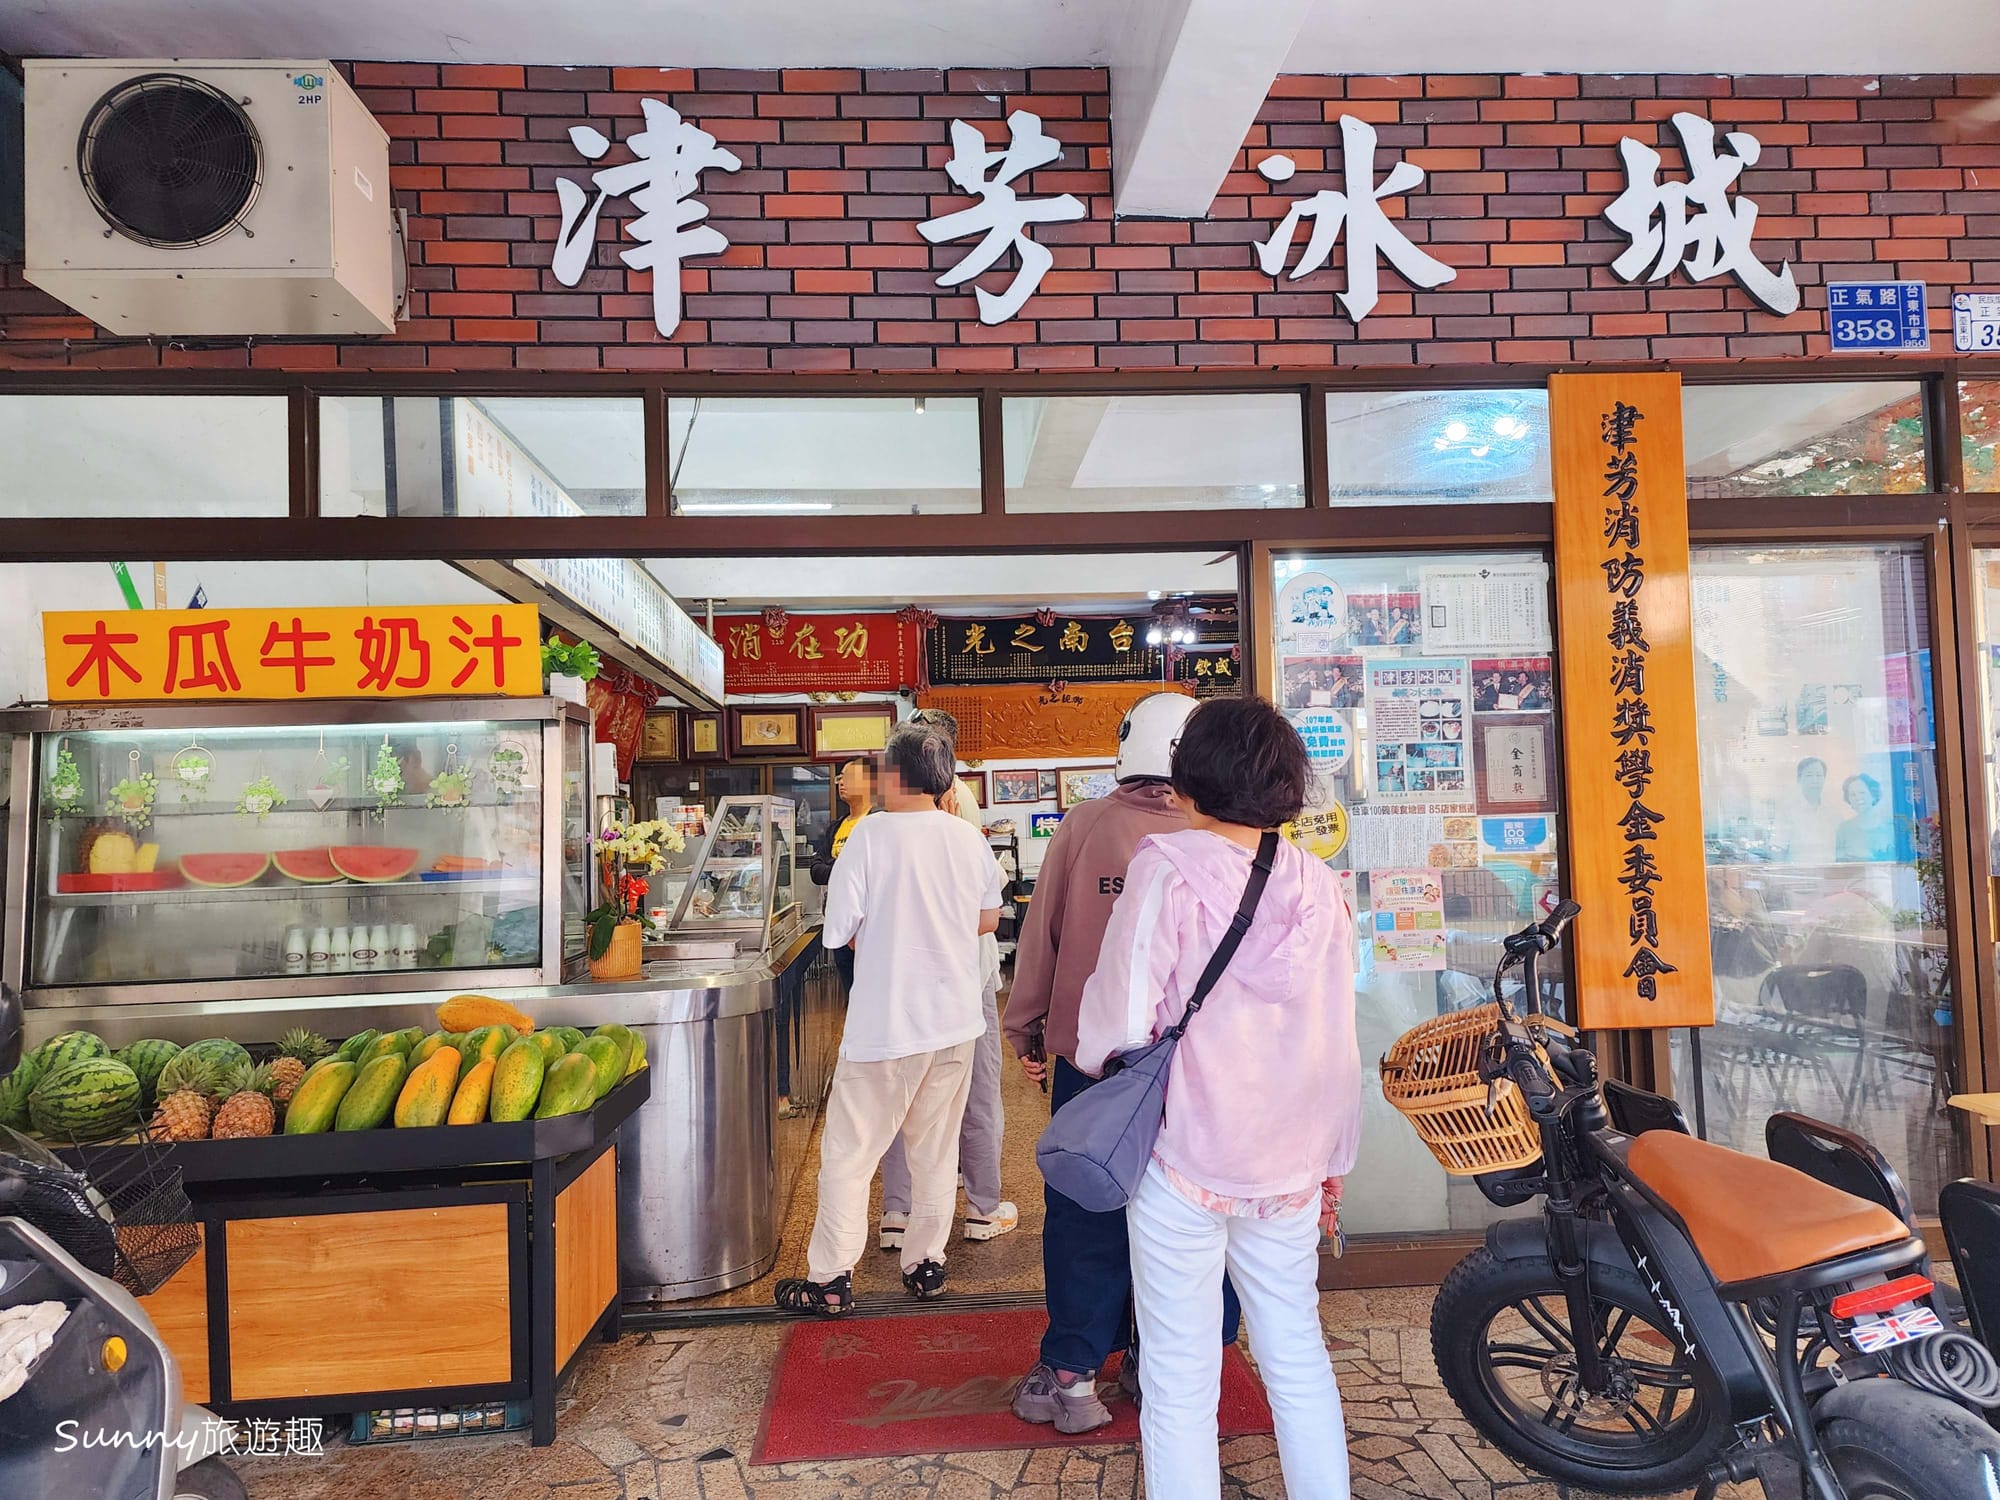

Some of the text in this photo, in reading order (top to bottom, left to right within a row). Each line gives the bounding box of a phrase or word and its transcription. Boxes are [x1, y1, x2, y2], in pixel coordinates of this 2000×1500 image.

[298, 95, 322, 104] 2HP
[551, 97, 1802, 338] 津芳冰城
[1831, 288, 1897, 306] 正氣路
[1906, 285, 1921, 327] 台東市
[1836, 319, 1896, 341] 358
[1904, 339, 1926, 348] 950
[961, 620, 1135, 655] 台南之光
[62, 614, 523, 697] 木瓜牛奶汁
[1600, 401, 1678, 1002] 津芳消防義消獎學金委員會
[1289, 812, 1338, 829] 本店免用
[1290, 824, 1341, 841] 統一發票
[1504, 829, 1525, 838] 100
